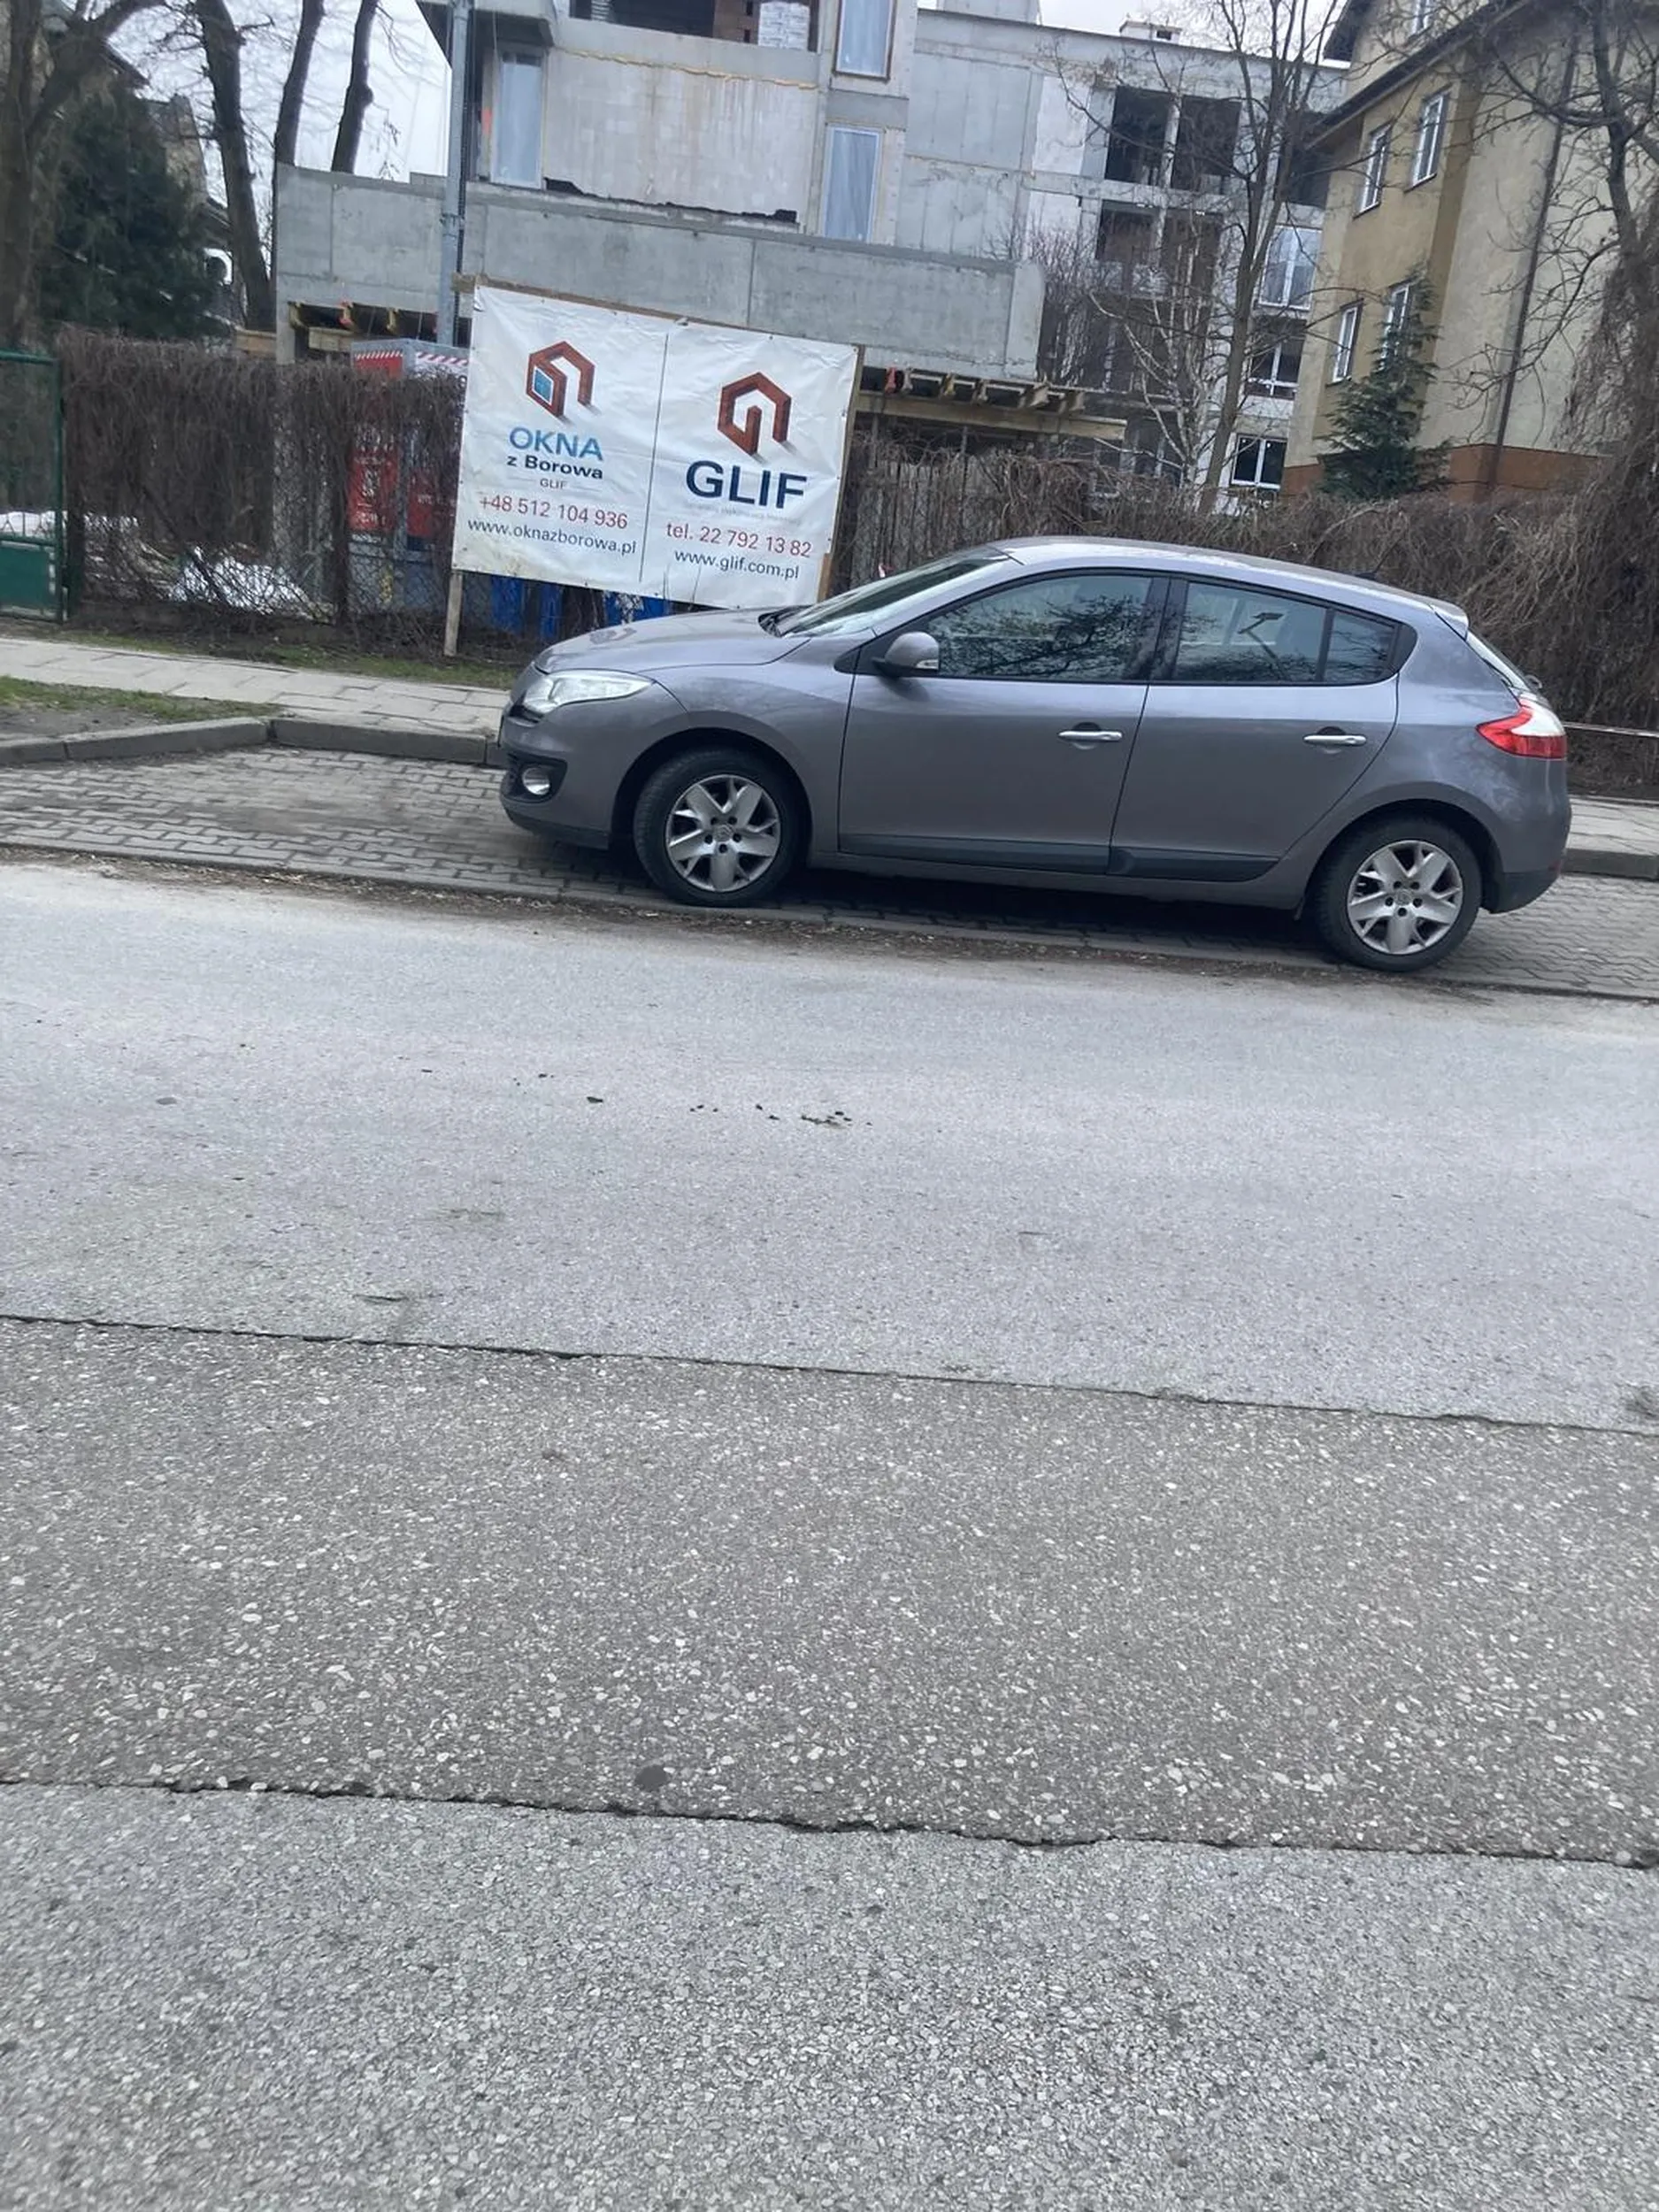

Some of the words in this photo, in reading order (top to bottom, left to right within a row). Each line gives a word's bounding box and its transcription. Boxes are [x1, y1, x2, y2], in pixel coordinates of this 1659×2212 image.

[510, 426, 603, 461] OKNA
[506, 456, 517, 467] z
[525, 455, 603, 480] Borowa
[540, 478, 568, 489] GLIF
[686, 460, 807, 509] GLIF
[480, 495, 512, 513] +48
[518, 497, 550, 518] 512
[559, 504, 588, 523] 104
[595, 510, 628, 529] 936
[468, 519, 636, 556] www.oknazborowa.pl
[666, 523, 693, 540] tel.
[699, 526, 721, 544] 22
[727, 530, 758, 549] 792
[766, 536, 786, 554] 13
[790, 540, 811, 557] 82
[674, 550, 800, 580] www.glif.com.pl
